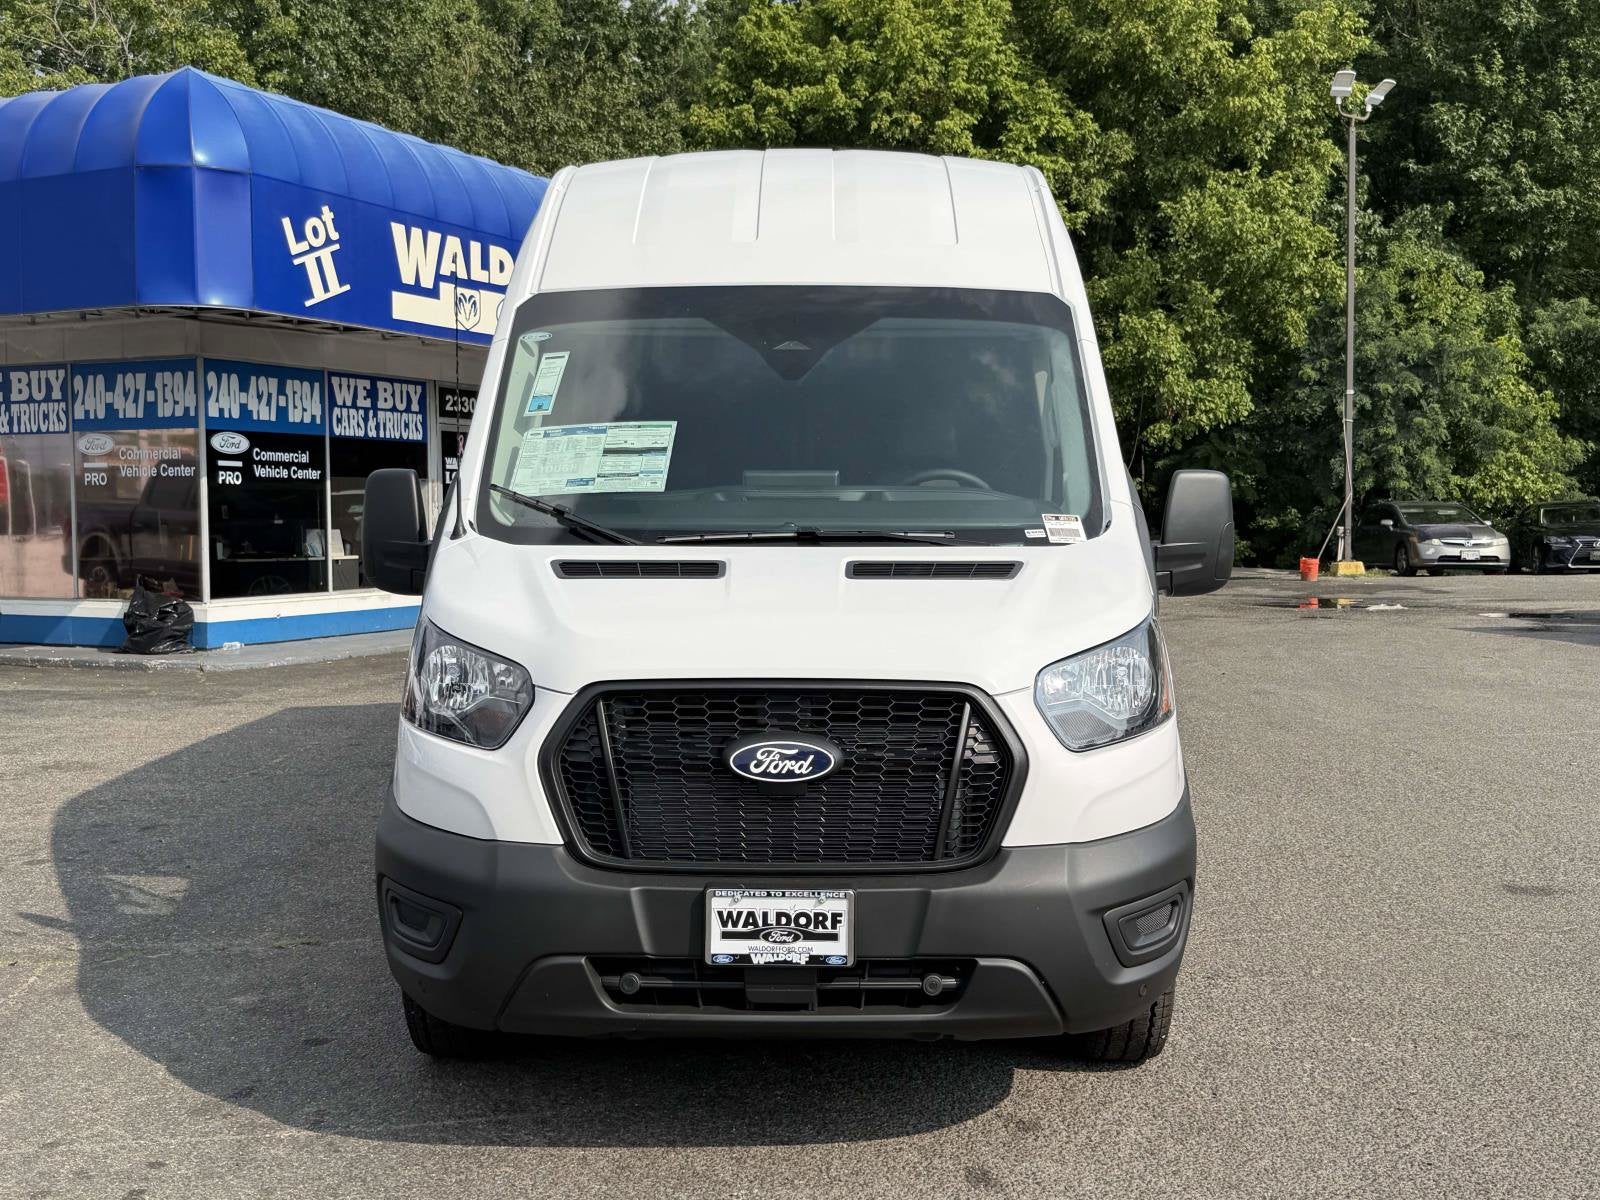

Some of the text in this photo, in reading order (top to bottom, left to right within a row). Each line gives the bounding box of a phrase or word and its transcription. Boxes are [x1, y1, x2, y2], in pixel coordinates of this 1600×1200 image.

[281, 205, 339, 256] Lot
[292, 243, 350, 307] II
[9, 369, 66, 402] BUY
[73, 371, 197, 420] 240-427-1394
[330, 376, 422, 412] WE BUY
[206, 370, 322, 425] 240-427-1394
[11, 401, 67, 433] TRUCKS
[332, 406, 423, 440] CARS & TRUCKS
[119, 447, 182, 461] Commercial
[253, 448, 310, 463] Commercial
[84, 472, 108, 486] PRO
[120, 463, 196, 477] Vehicle Center
[218, 470, 242, 485] PRO
[253, 465, 321, 481] Vehicle Center
[750, 747, 814, 774] Ford
[716, 910, 843, 930] WALDORF
[768, 931, 795, 943] Ford
[747, 945, 814, 953] WALDORFFORD.COM
[750, 952, 810, 965] WALDORF
